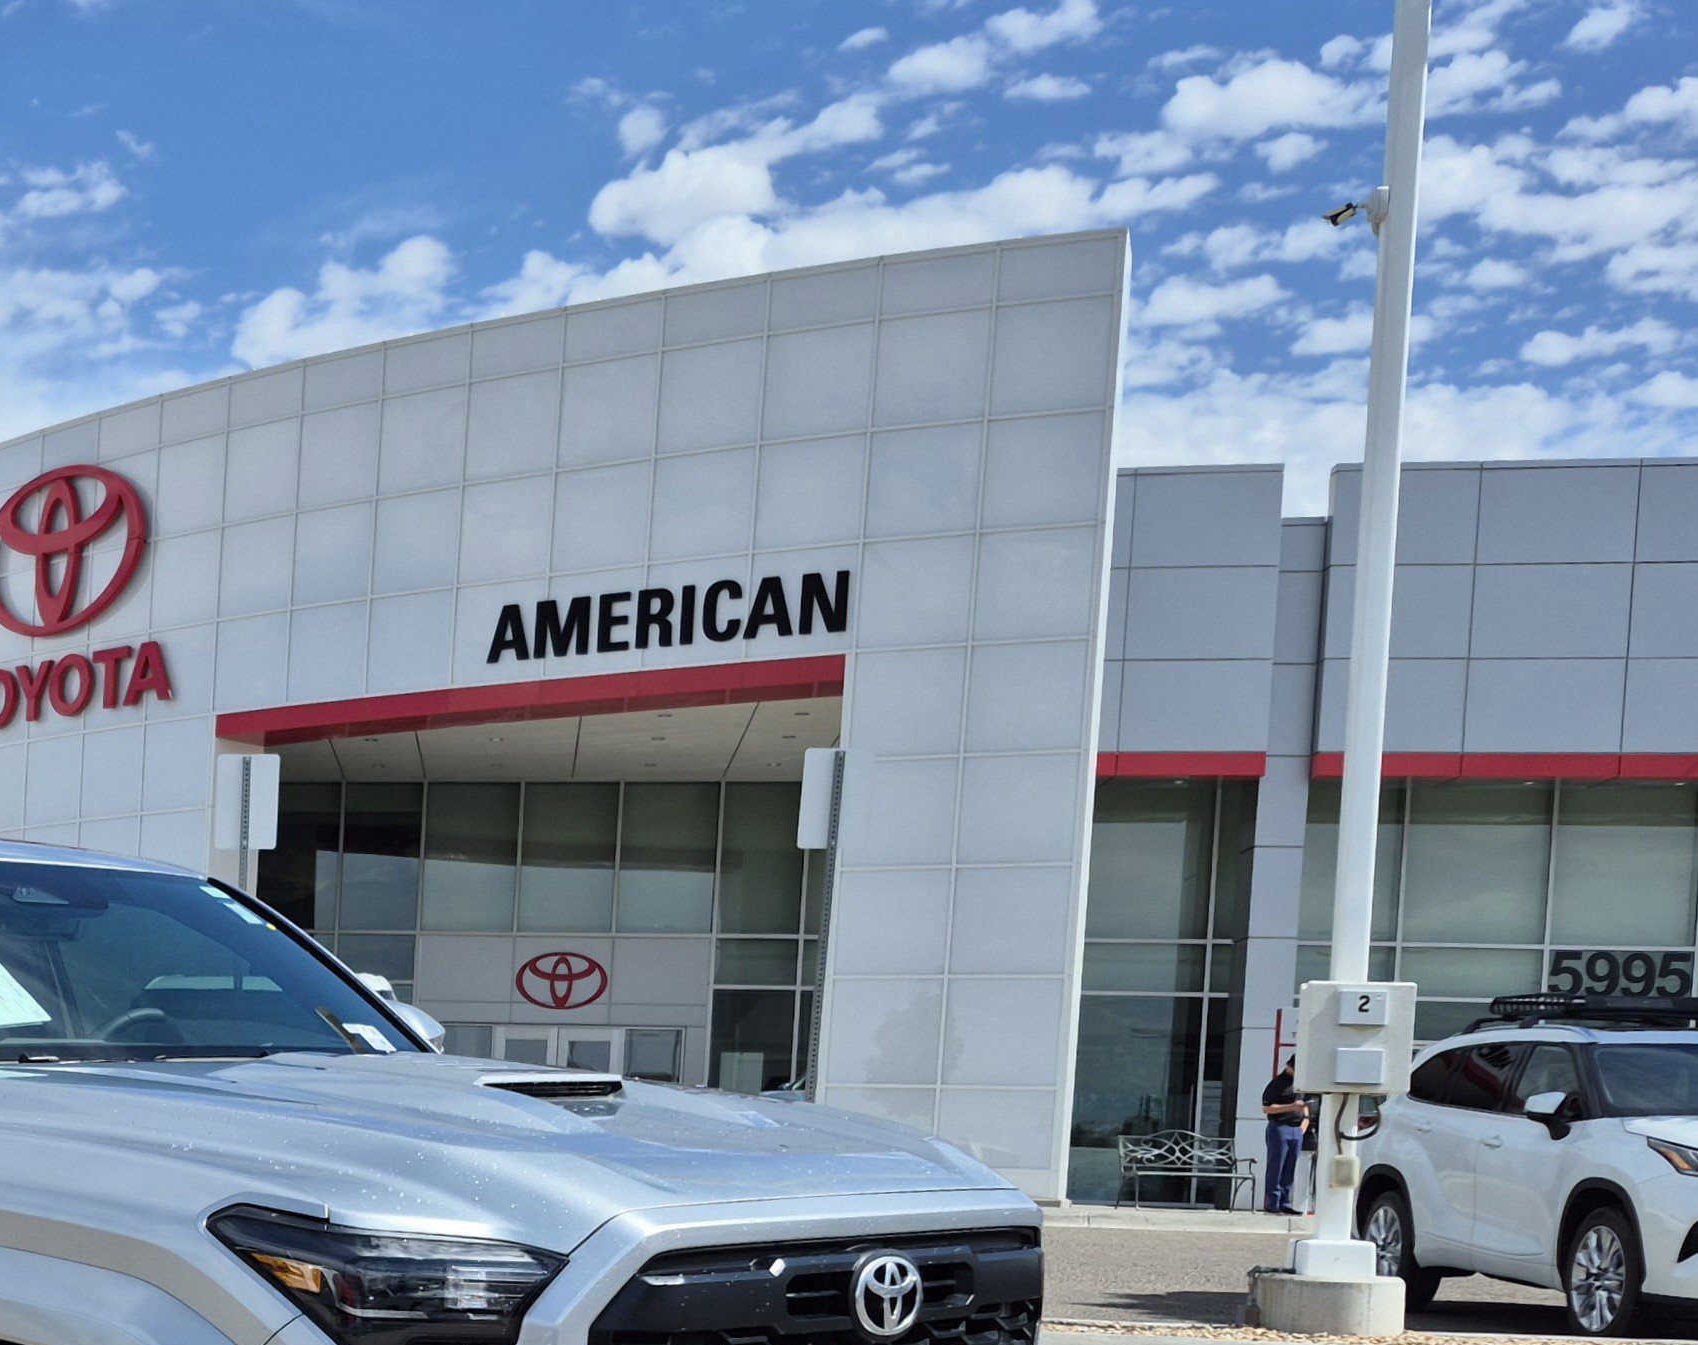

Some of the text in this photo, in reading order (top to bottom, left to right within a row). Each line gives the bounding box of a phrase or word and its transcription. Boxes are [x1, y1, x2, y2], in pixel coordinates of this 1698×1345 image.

[486, 570, 850, 664] AMERICAN
[1547, 951, 1693, 998] 5995
[1357, 995, 1371, 1013] 2
